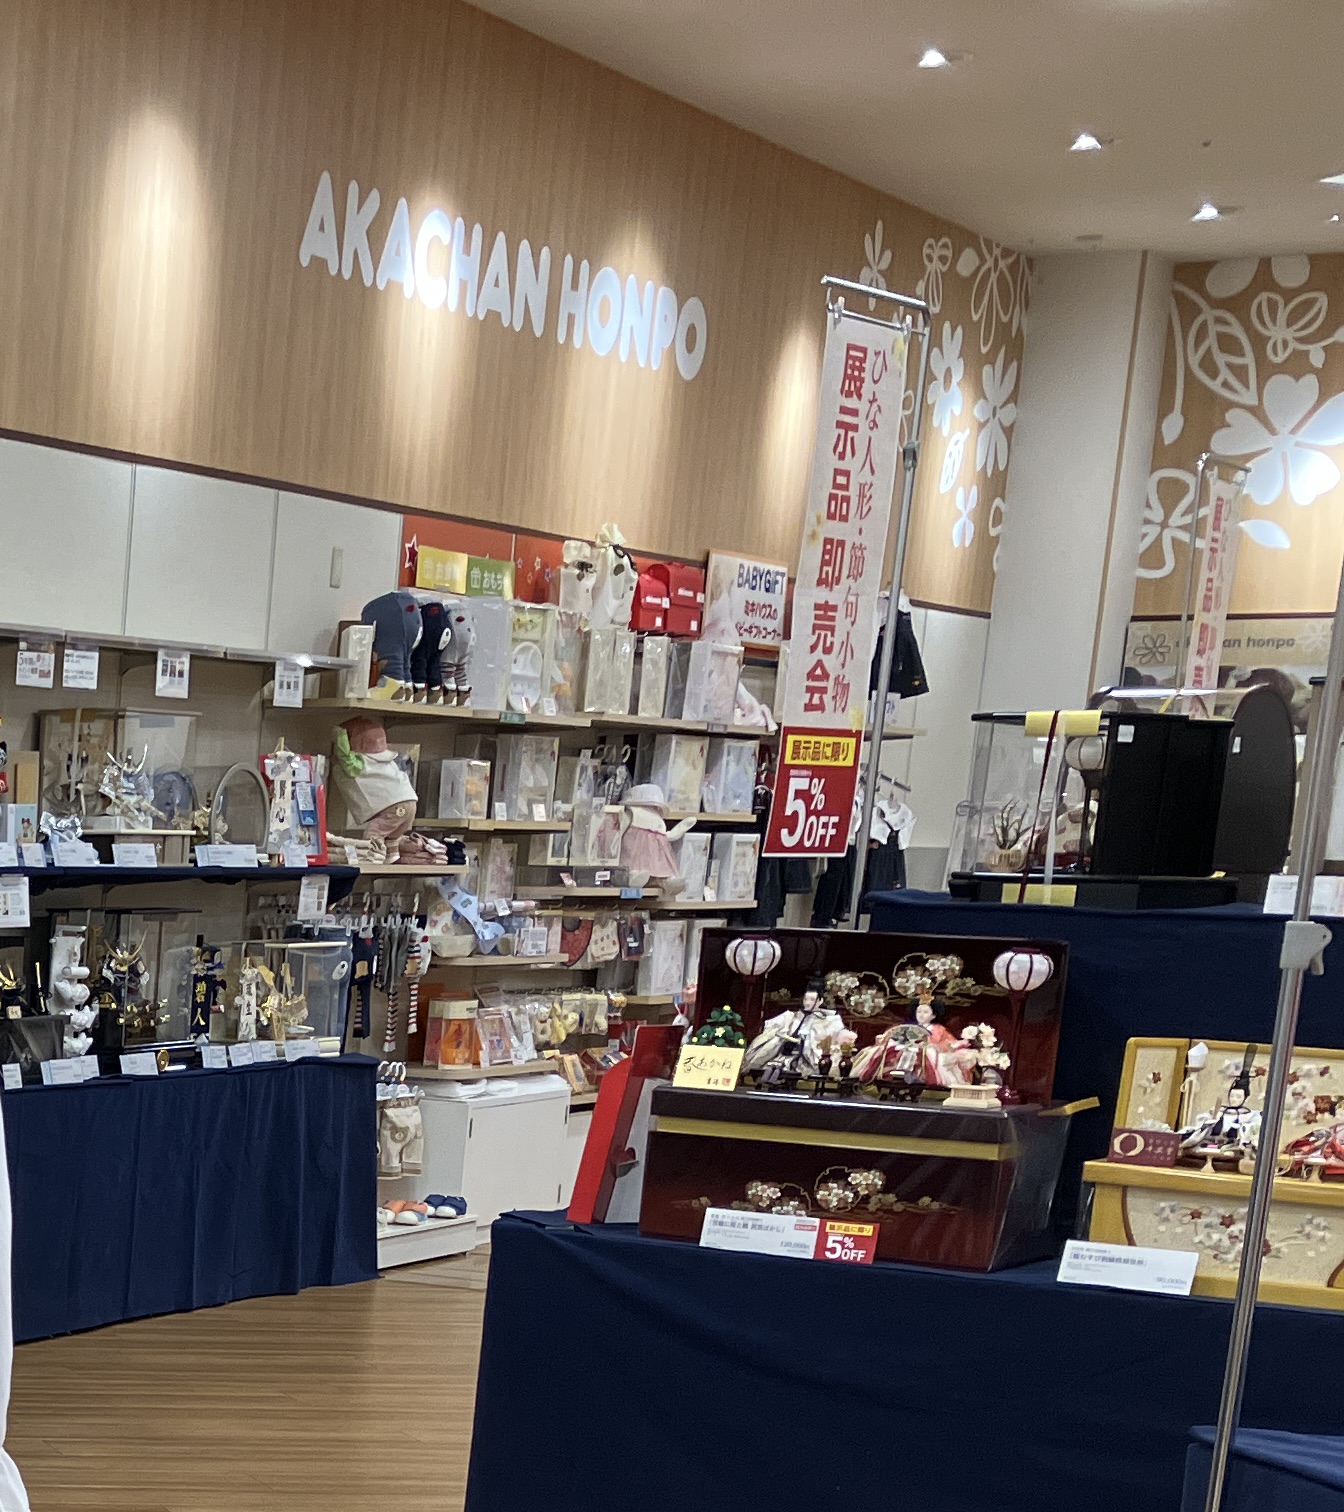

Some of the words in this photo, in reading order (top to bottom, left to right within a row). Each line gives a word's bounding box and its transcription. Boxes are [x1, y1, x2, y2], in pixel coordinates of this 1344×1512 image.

[299, 170, 552, 338] AKACHAN
[557, 253, 708, 381] HONPO
[803, 342, 869, 715] 展示品即売会
[831, 348, 889, 715] ひな人形・節句小物
[791, 739, 850, 762] 展示品に限り
[803, 815, 840, 848] OFF
